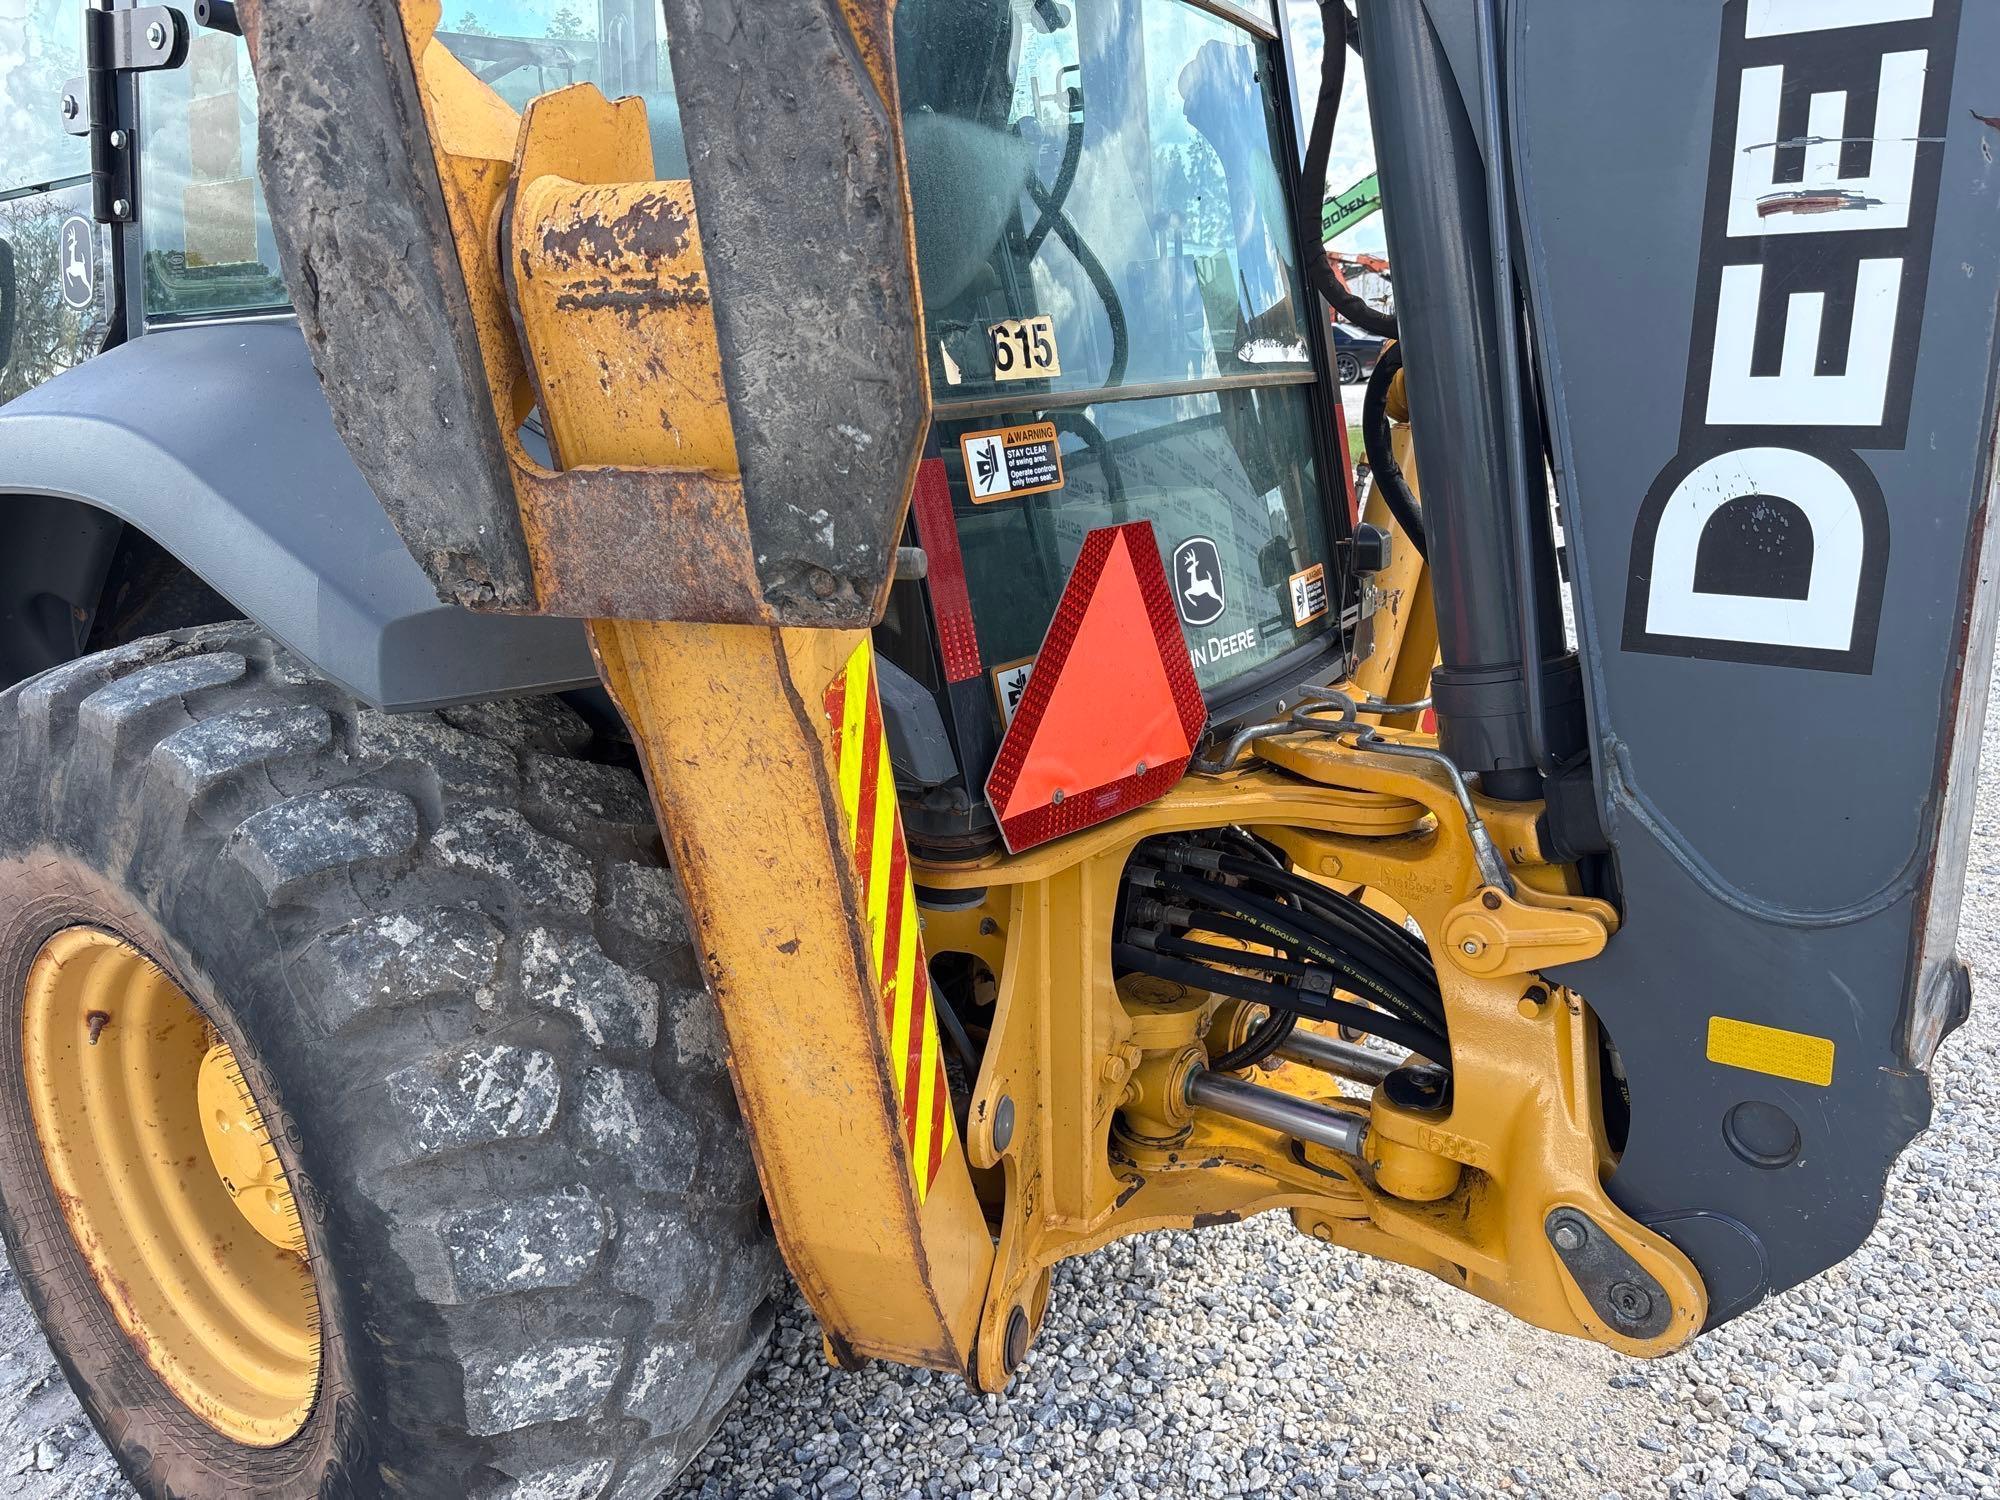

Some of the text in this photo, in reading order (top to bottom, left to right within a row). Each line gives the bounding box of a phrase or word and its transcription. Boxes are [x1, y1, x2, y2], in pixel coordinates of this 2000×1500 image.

[1645, 0, 1934, 652] DEE
[991, 323, 1053, 372] 615
[1014, 427, 1054, 442] WARNING
[1007, 445, 1047, 459] STAY CLEAR
[1008, 455, 1047, 467] of swing area.
[1010, 464, 1057, 478] Operate controls
[1012, 473, 1053, 487] only from seat.
[1208, 628, 1256, 663] DEERE
[1260, 923, 1299, 944] AEROQUIP
